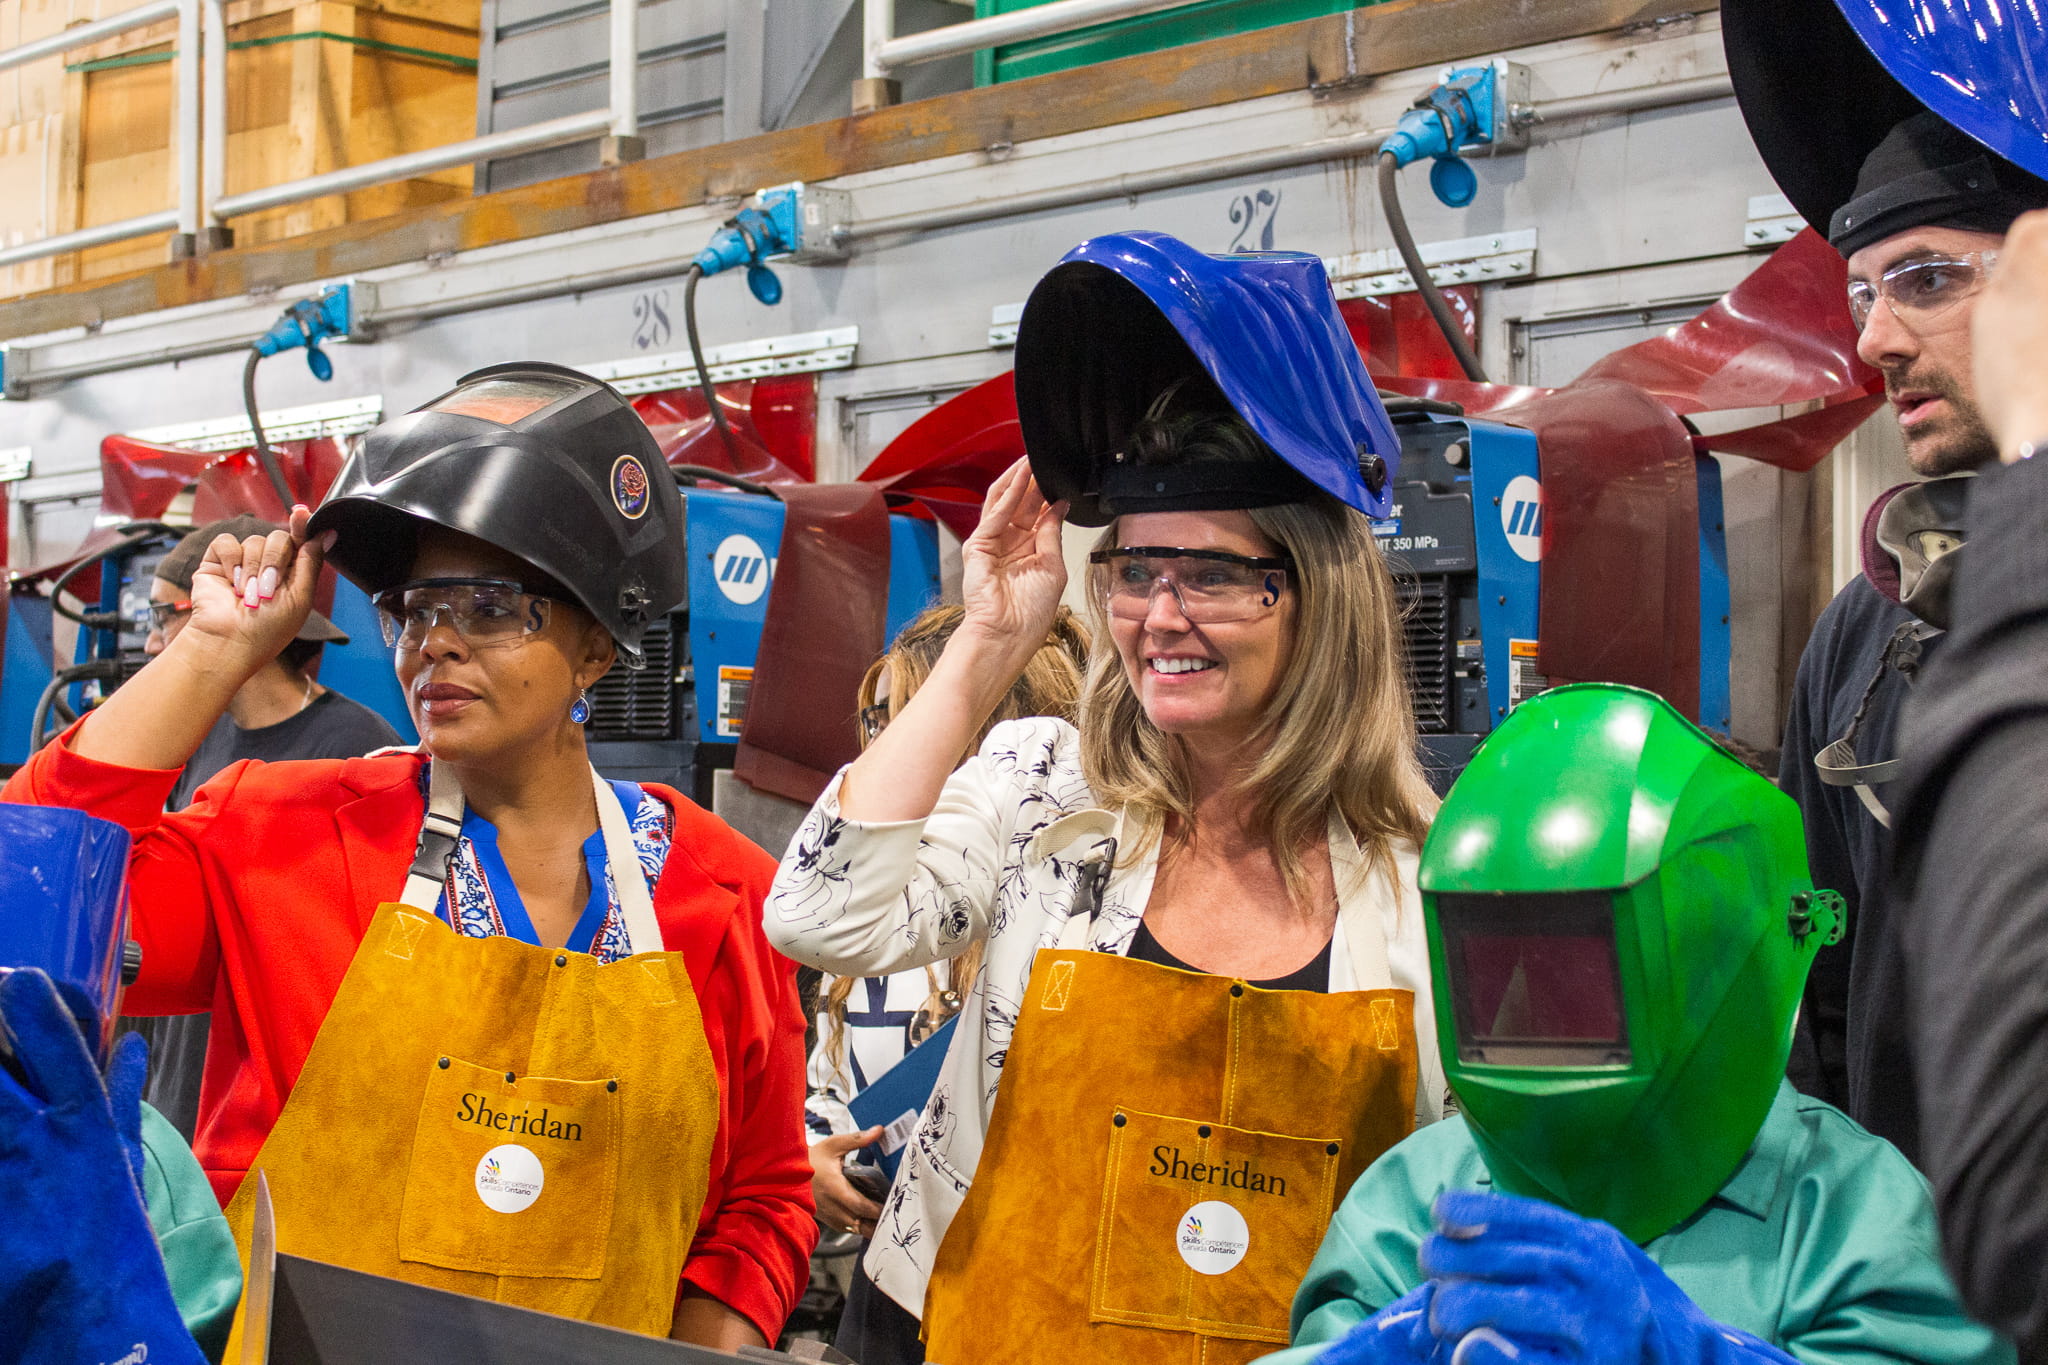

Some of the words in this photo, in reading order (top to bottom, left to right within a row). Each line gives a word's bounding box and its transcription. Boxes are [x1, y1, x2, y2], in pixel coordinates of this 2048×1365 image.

[1228, 188, 1282, 252] 27
[631, 289, 671, 349] 28
[1393, 537, 1412, 550] 350
[1415, 536, 1438, 549] MPa
[1262, 572, 1280, 607] S
[527, 600, 544, 631] S
[456, 1092, 583, 1141] Sheridan
[1149, 1145, 1287, 1197] Sheridan
[504, 1186, 532, 1196] Ontario
[1182, 1236, 1201, 1244] Skills
[1208, 1246, 1236, 1255] Ontario
